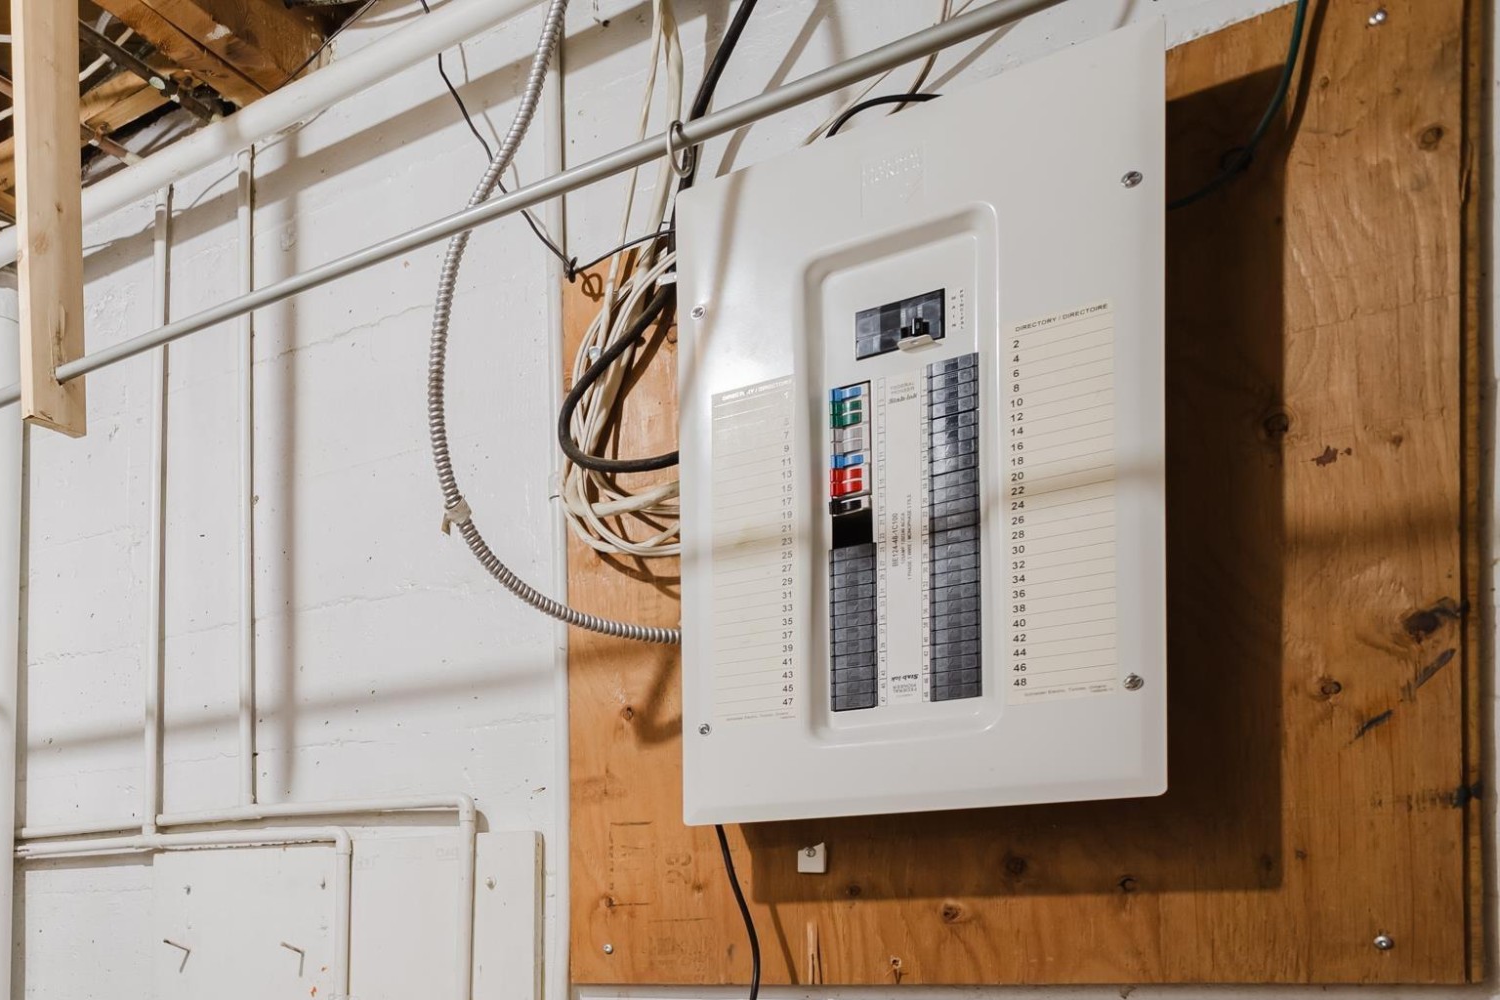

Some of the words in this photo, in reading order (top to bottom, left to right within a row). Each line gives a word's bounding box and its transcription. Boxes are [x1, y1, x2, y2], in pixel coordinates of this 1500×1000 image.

[1015, 317, 1057, 332] DIRECTORY
[1062, 303, 1108, 320] DIRECTOIRE
[1013, 340, 1019, 348] 2
[1013, 354, 1020, 362] 4
[1013, 369, 1019, 377] 6
[1013, 384, 1019, 392] 8
[1010, 398, 1023, 407] 10
[1009, 413, 1023, 422] 12
[1010, 427, 1023, 436] 14
[1010, 442, 1023, 451] 16
[781, 457, 791, 466] 11
[1010, 457, 1024, 466] 18
[782, 470, 792, 479] 13
[1010, 472, 1024, 482] 20
[782, 484, 792, 492] 15
[1010, 486, 1025, 496] 22
[782, 497, 792, 506] 17
[1010, 501, 1025, 510] 24
[783, 511, 792, 519] 19
[1011, 516, 1024, 525] 26
[782, 524, 791, 532] 21
[1011, 530, 1025, 540] 28
[781, 537, 792, 546] 23
[782, 550, 792, 559] 25
[1011, 545, 1025, 555] 30
[782, 564, 792, 573] 27
[1011, 560, 1025, 570] 32
[782, 577, 793, 586] 29
[1011, 574, 1025, 583] 34
[782, 590, 791, 599] 31
[1012, 589, 1026, 599] 36
[782, 604, 793, 613] 33
[1012, 604, 1026, 613] 38
[782, 617, 793, 626] 35
[1011, 619, 1026, 628] 40
[782, 630, 793, 639] 37
[1012, 634, 1026, 642] 42
[782, 644, 793, 653] 39
[1012, 648, 1026, 657] 44
[782, 657, 792, 666] 41
[1012, 663, 1027, 672] 46
[782, 670, 793, 679] 43
[1012, 678, 1027, 686] 48
[782, 684, 793, 693] 45
[782, 697, 794, 706] 47
